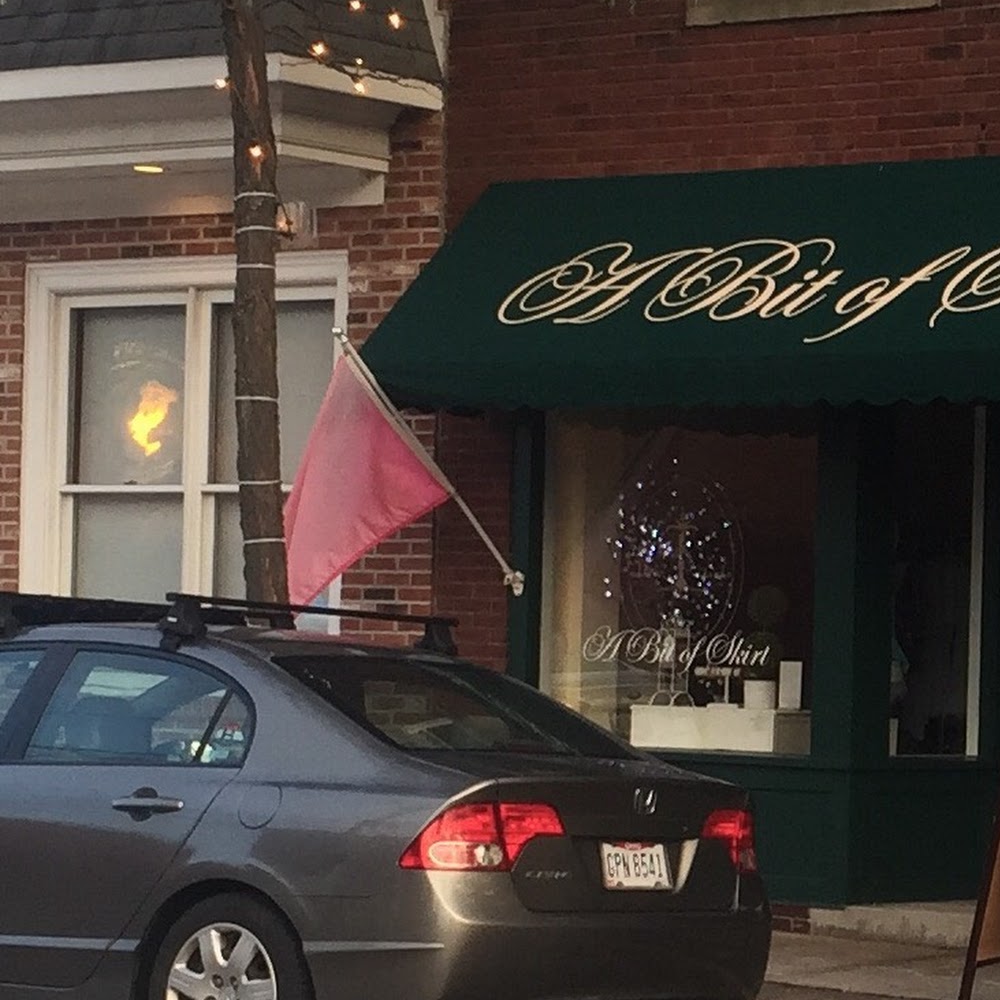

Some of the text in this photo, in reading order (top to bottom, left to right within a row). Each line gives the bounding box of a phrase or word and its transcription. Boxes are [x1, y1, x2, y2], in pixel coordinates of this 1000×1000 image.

[497, 242, 714, 326] A
[644, 238, 845, 323] Bit
[802, 245, 972, 344] of
[583, 625, 637, 662] A
[678, 634, 706, 678] of
[705, 629, 770, 667] Skirt
[632, 852, 664, 878] 8541
